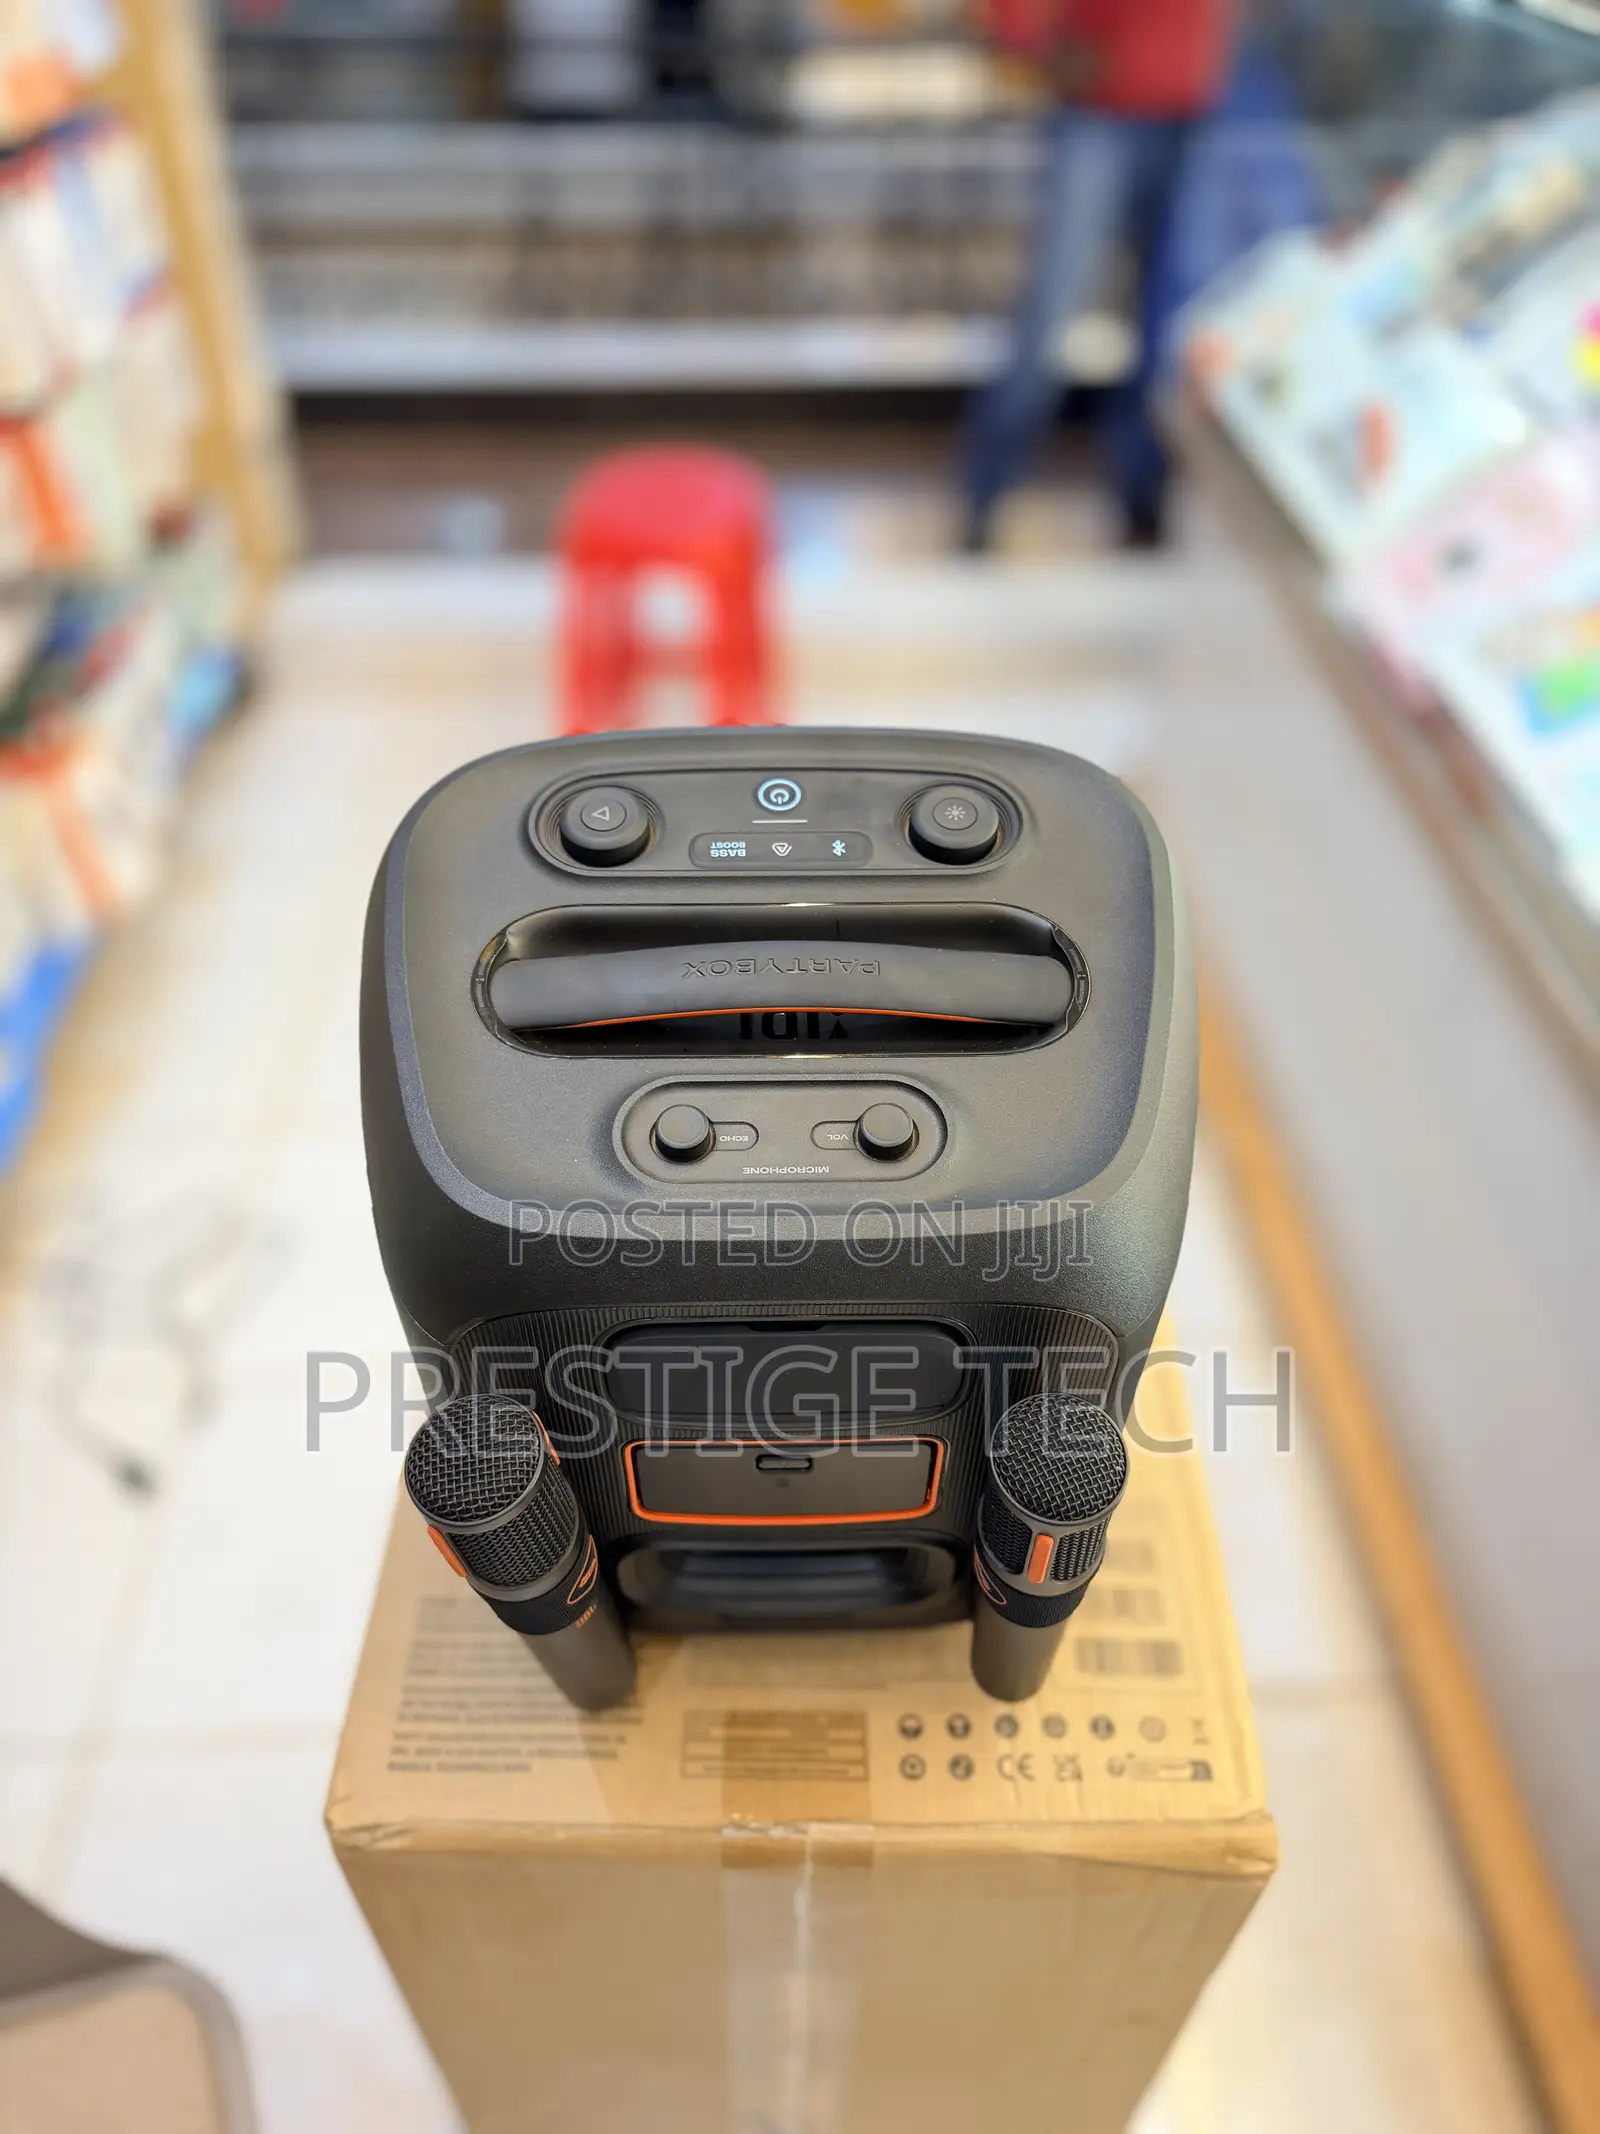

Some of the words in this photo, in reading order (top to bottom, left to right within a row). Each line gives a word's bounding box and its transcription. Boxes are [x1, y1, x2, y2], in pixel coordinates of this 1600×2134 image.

[710, 841, 746, 849] BOOST
[710, 849, 746, 857] BASS
[682, 957, 881, 979] PARTYBOX
[719, 1134, 749, 1142] ECHO
[742, 1165, 830, 1174] MICROPHONE
